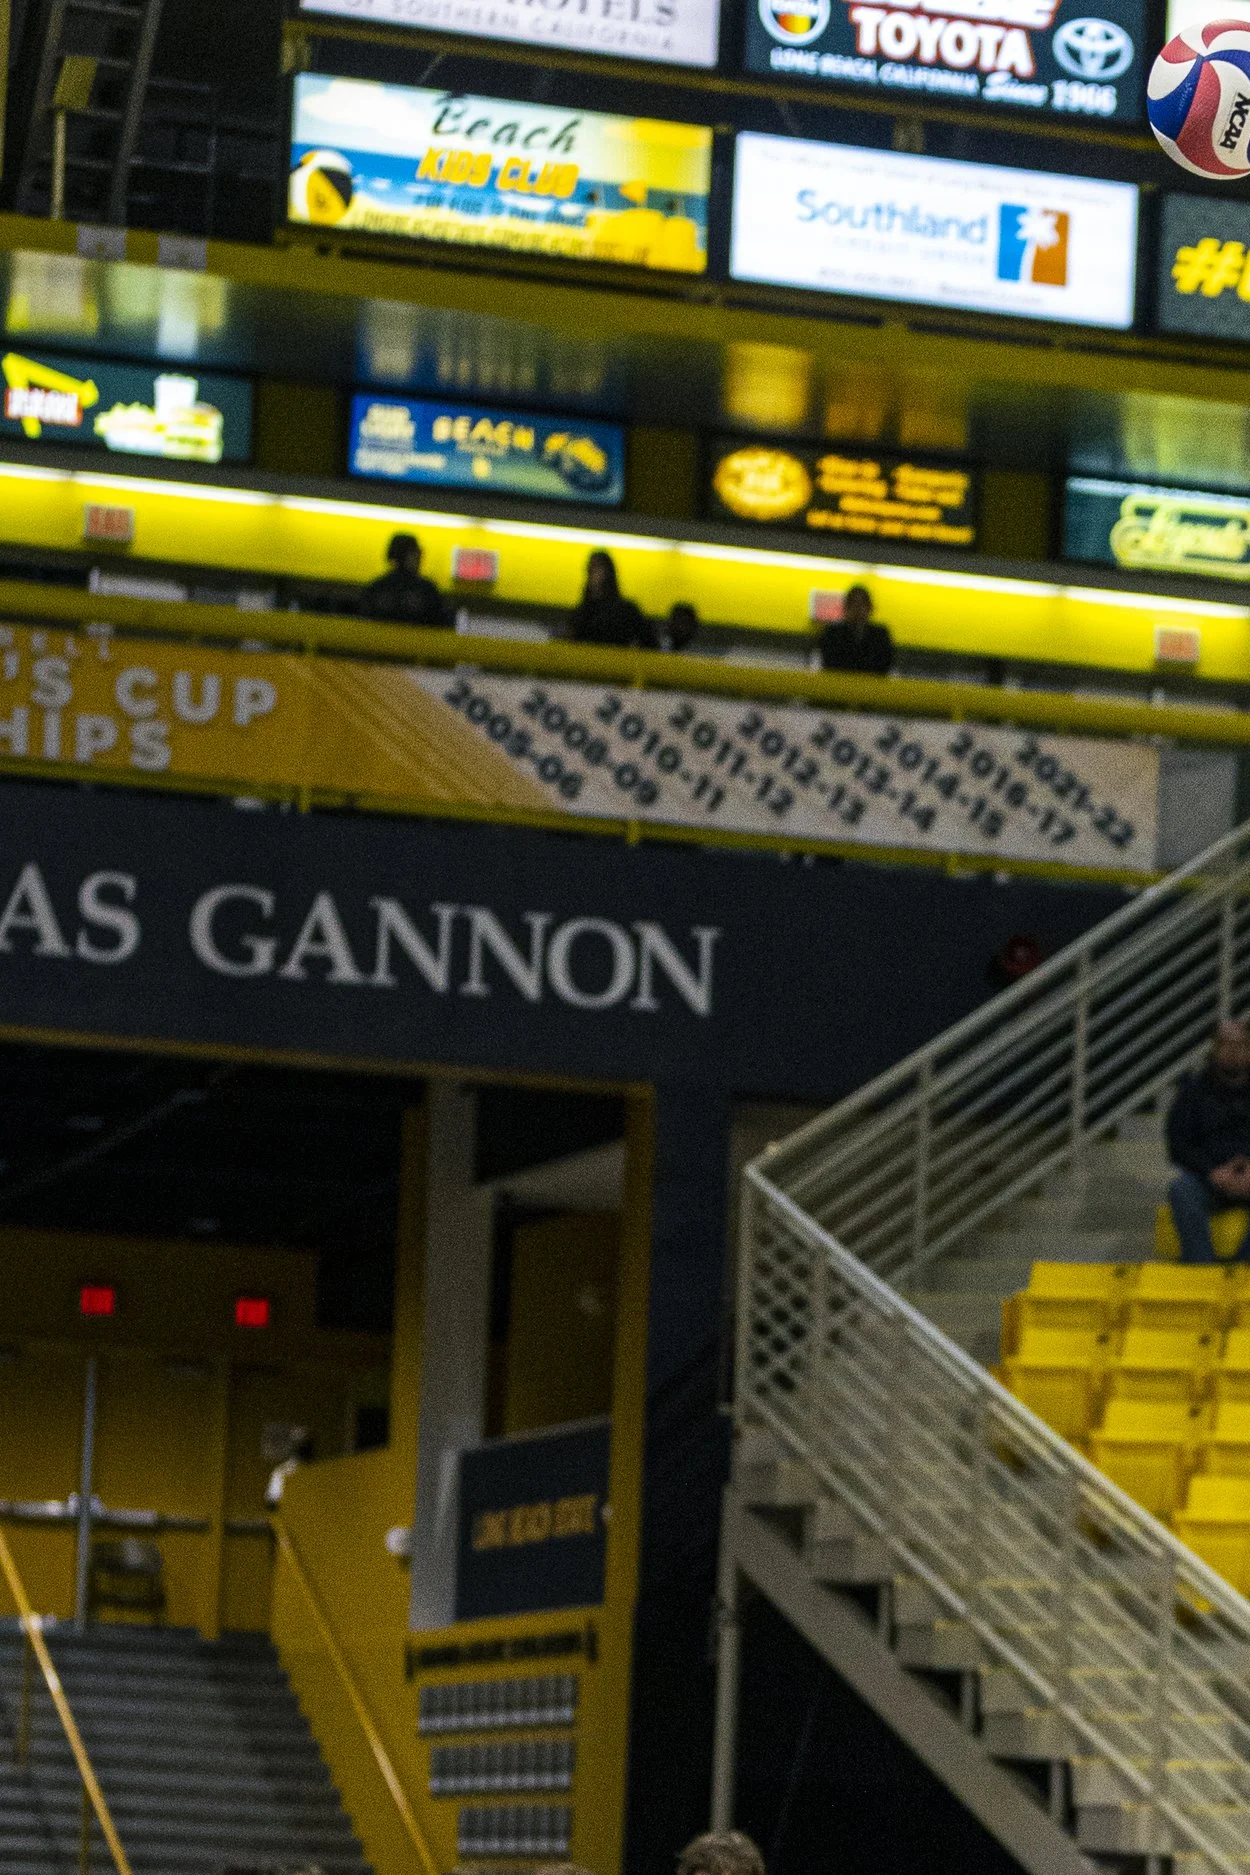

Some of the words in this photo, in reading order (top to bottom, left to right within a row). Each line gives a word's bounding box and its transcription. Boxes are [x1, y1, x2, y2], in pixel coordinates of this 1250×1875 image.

[850, 6, 1036, 77] TOYOTA
[433, 94, 581, 153] Beach
[416, 147, 493, 188] KIDS
[495, 155, 579, 198] CLUB
[795, 188, 988, 245] Southland
[115, 666, 277, 726] CUP
[596, 695, 726, 812] 2010-11
[670, 702, 795, 816] 2011-12
[0, 862, 141, 965] AS
[189, 884, 722, 1017] GANNON
